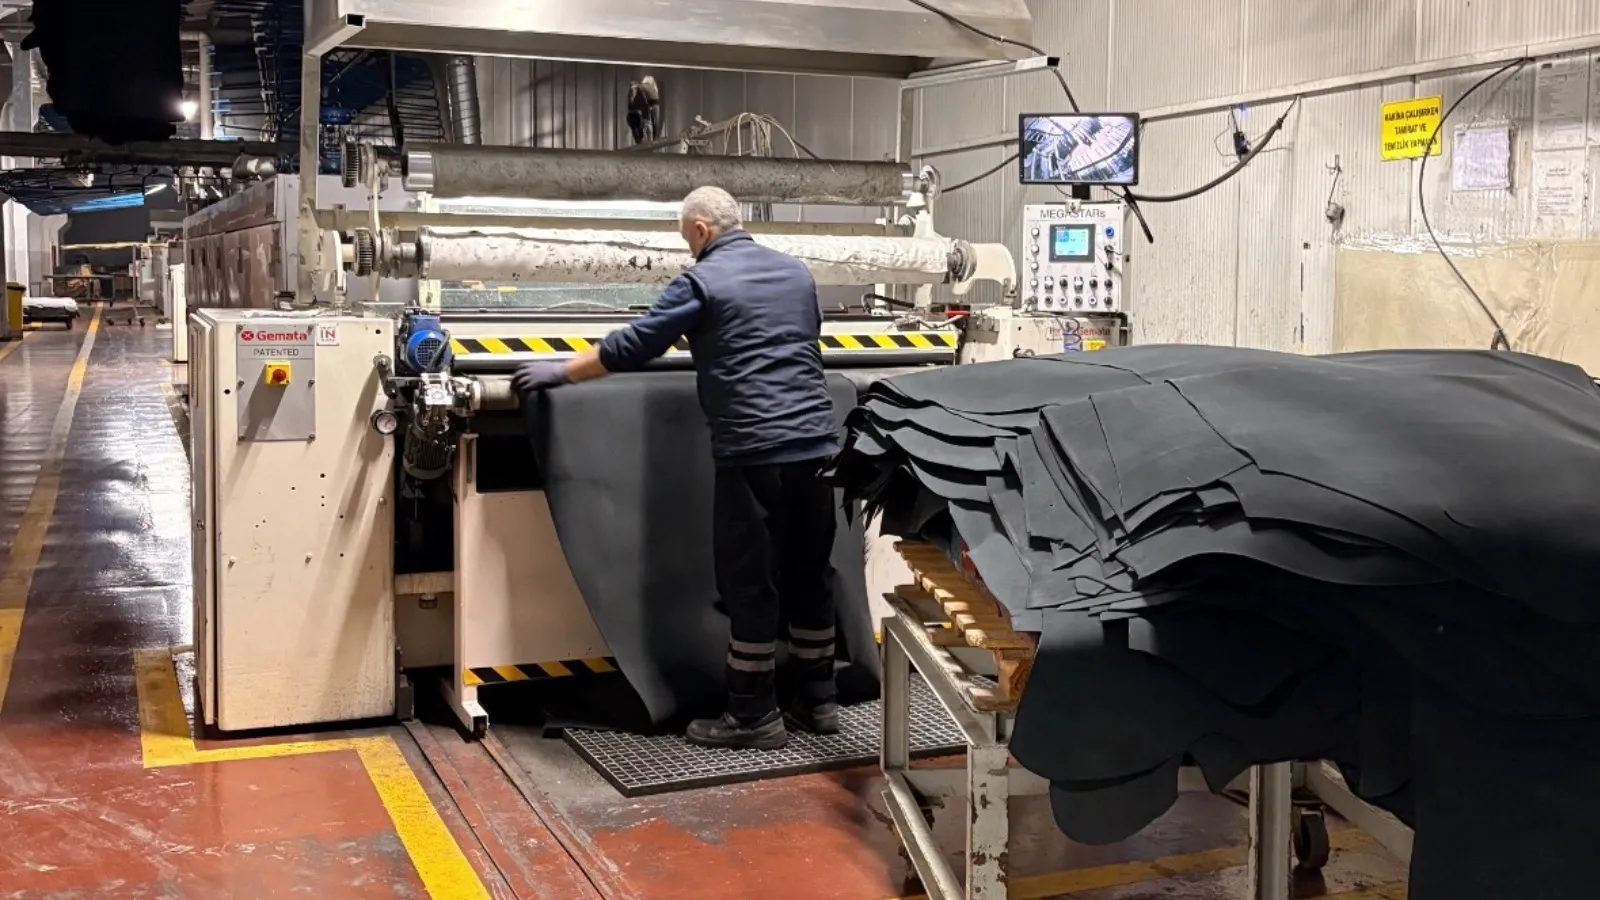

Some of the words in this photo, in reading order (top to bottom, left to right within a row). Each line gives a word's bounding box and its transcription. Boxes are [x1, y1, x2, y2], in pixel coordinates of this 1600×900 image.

[1419, 123, 1427, 132] VE
[1040, 208, 1106, 219] MEGASTARs
[256, 330, 308, 341] Gemata
[320, 329, 336, 339] IN
[1077, 327, 1111, 336] Gemata
[253, 348, 300, 356] PATENTED
